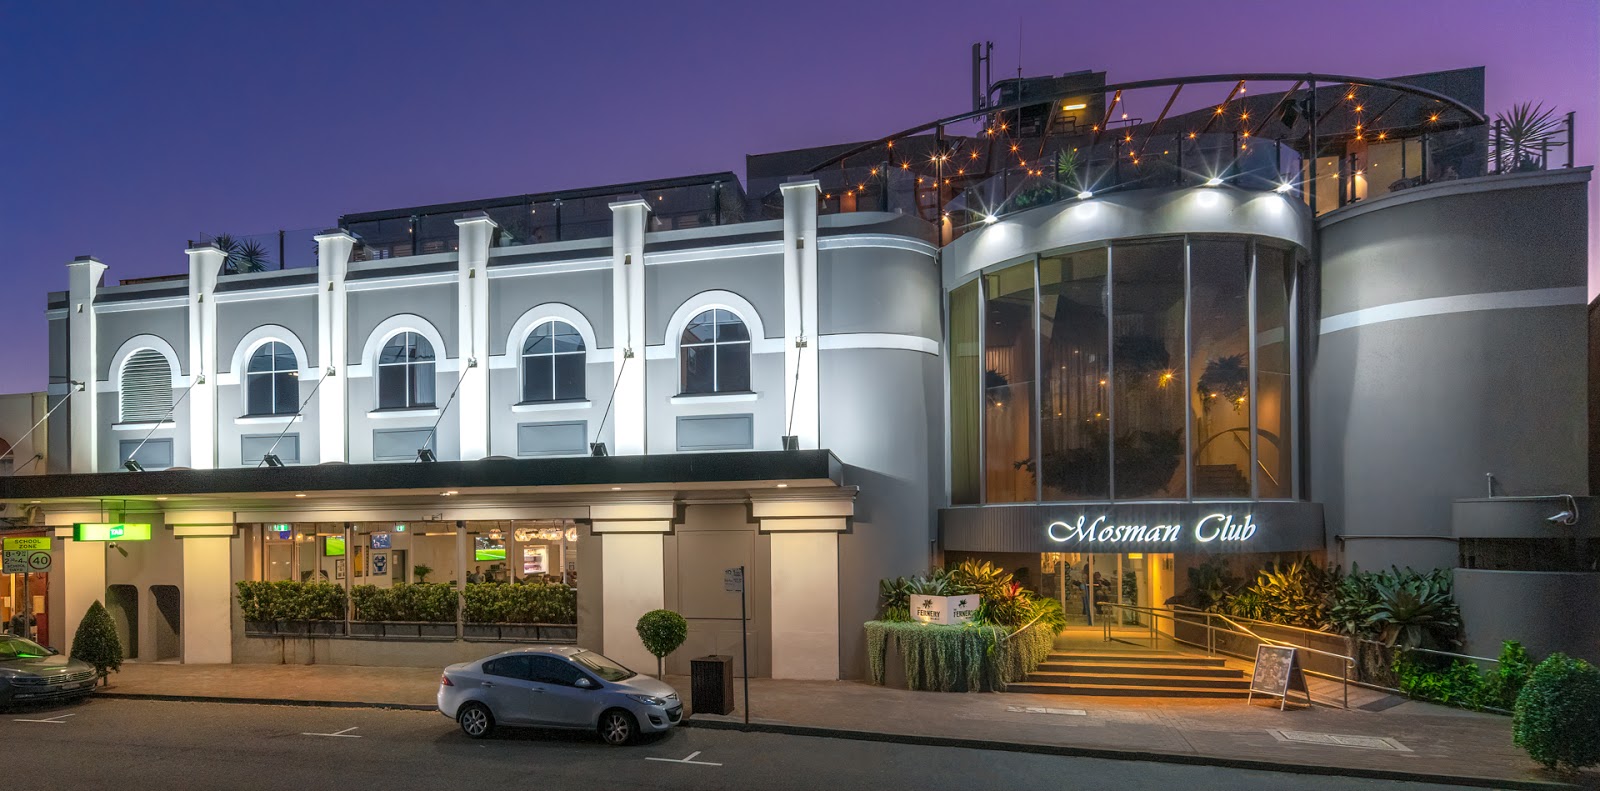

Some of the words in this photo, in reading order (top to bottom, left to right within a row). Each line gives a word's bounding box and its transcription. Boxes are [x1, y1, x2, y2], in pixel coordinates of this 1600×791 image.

[1048, 515, 1180, 542] Mosman
[1195, 513, 1256, 542] Club
[32, 556, 48, 565] 40
